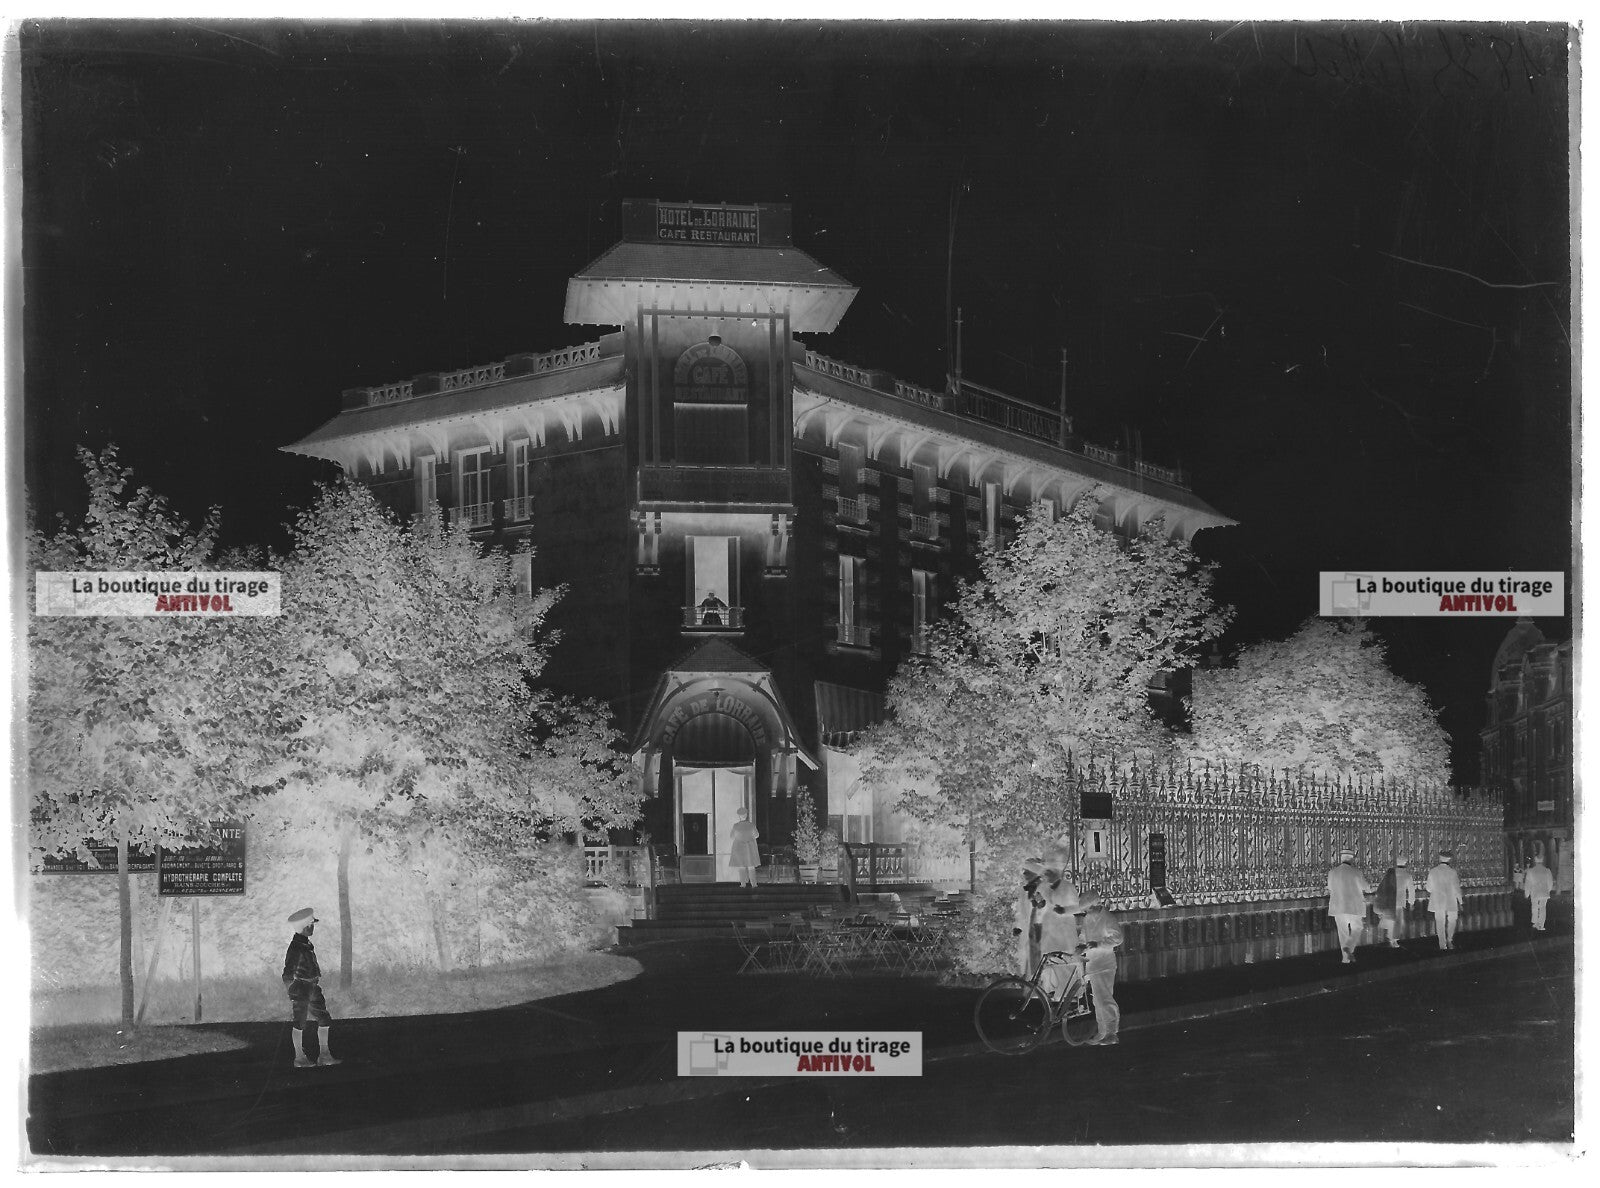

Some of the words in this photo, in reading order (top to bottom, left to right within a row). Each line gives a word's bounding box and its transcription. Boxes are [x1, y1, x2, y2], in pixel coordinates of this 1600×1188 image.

[659, 208, 693, 226] HOTEL
[703, 210, 756, 228] LORRAINE
[691, 229, 756, 243] RESTAURANT
[690, 698, 709, 715] DE
[716, 695, 766, 746] LORRAINE
